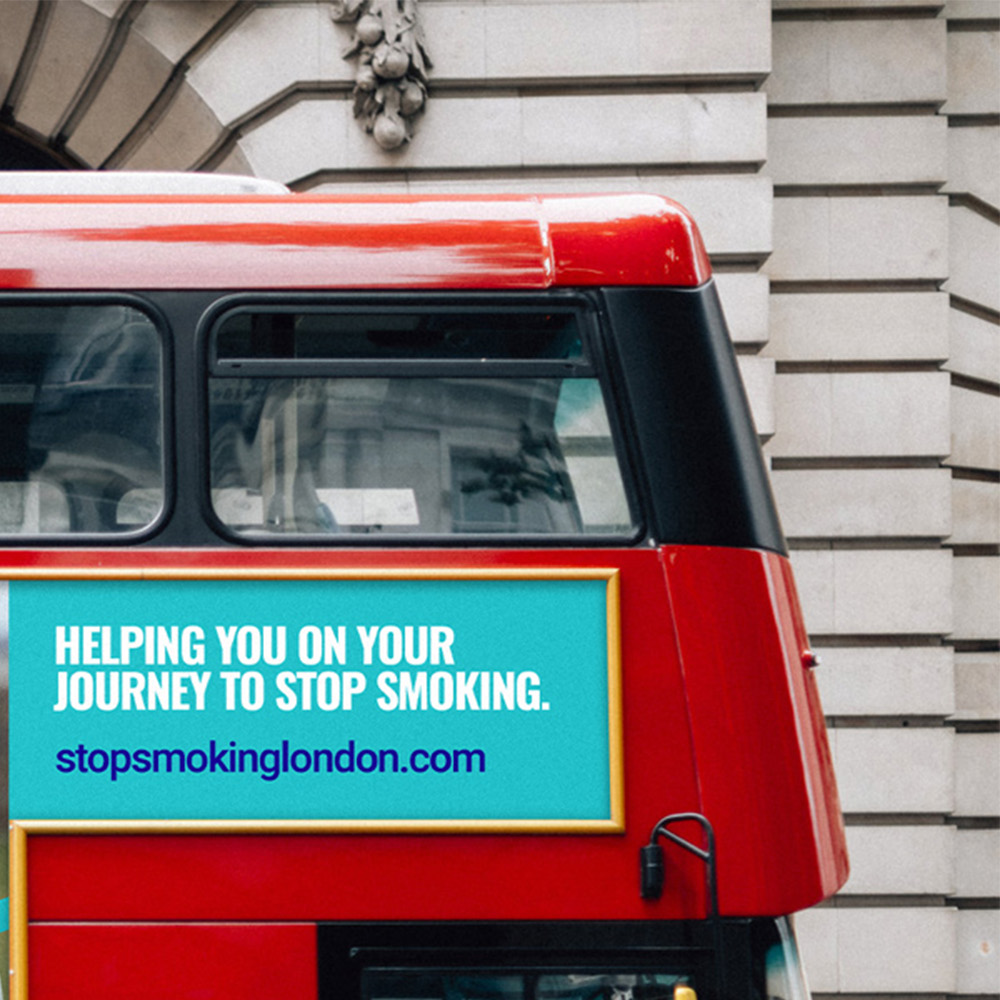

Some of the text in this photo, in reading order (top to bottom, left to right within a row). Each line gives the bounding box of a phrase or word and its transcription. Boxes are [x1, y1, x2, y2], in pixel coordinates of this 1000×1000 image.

[55, 626, 455, 666] HELPING YOU ON YOUR
[54, 670, 551, 712] JOURNEY TO STOP SMOKING.
[56, 740, 486, 781] stopsmokinglondon.com
